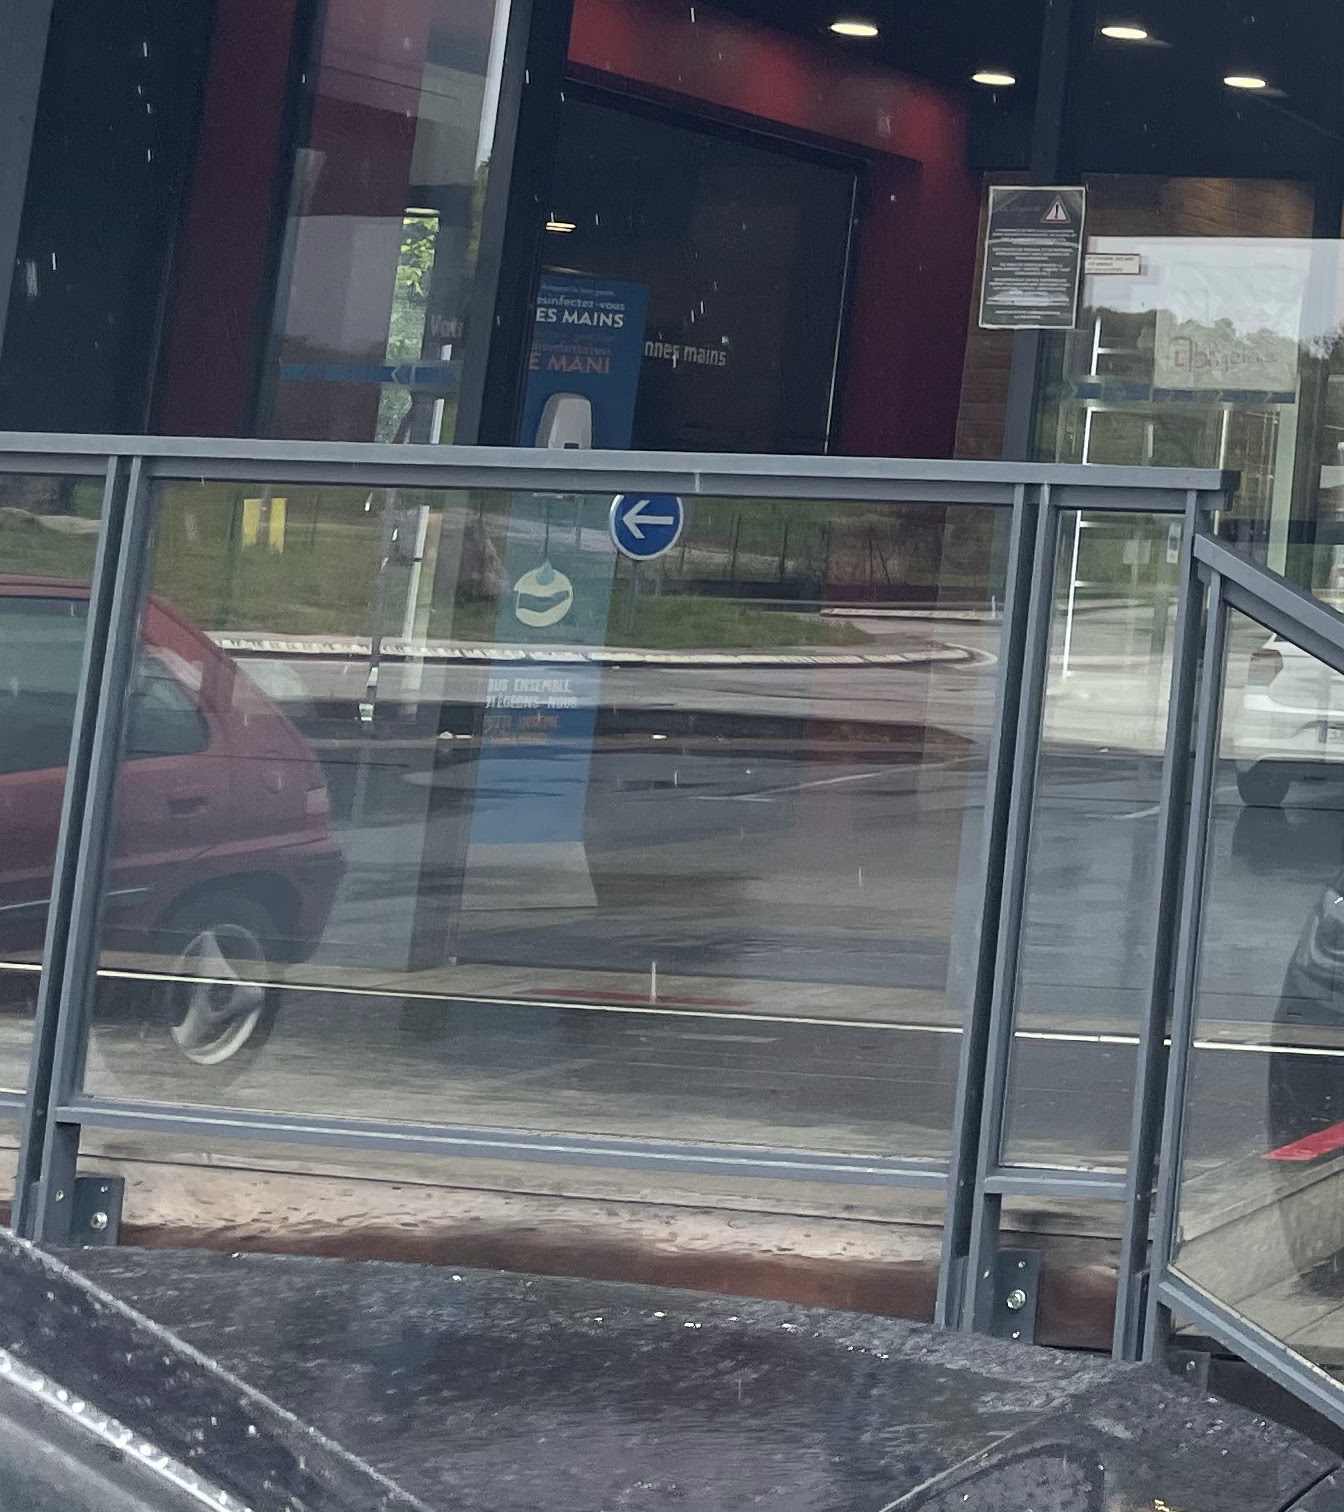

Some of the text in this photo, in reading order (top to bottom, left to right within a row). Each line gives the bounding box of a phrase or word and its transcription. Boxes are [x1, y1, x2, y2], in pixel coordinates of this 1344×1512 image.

[535, 306, 625, 329] ES MAINS
[644, 340, 727, 367] nnes mains
